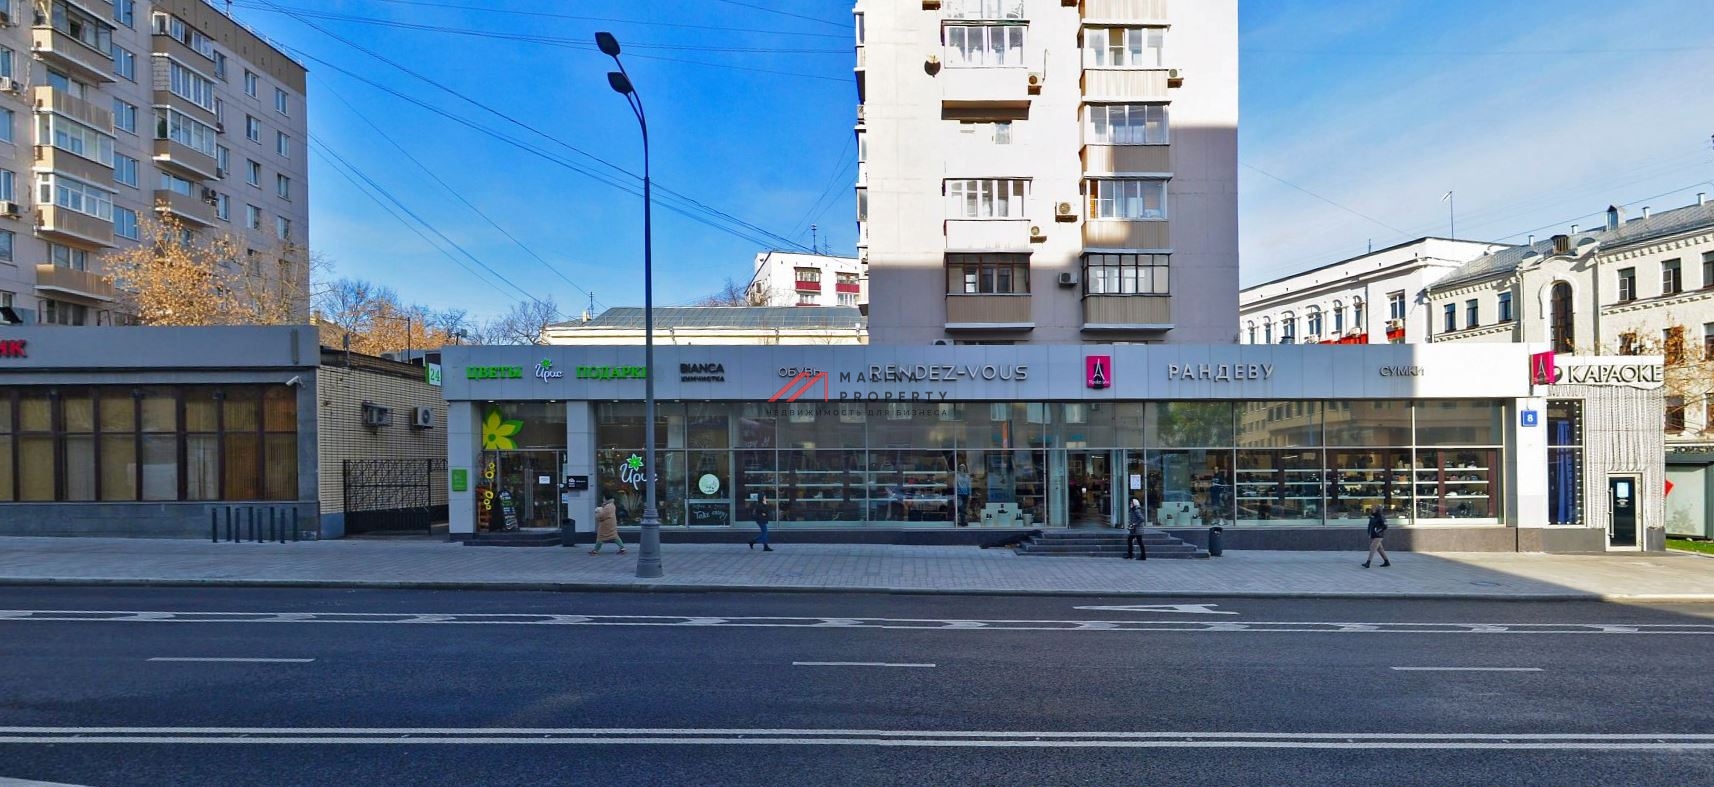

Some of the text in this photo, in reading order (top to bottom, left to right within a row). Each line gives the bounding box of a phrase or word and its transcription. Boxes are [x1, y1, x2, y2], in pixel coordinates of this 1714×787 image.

[430, 368, 440, 381] 24
[466, 366, 522, 379] ЦВЕТЫ
[535, 363, 563, 382] Ирис
[680, 362, 724, 374] BIANCA
[778, 366, 822, 377] ОБУВЬ
[869, 364, 1029, 382] RENDEZ-VOUS
[1168, 363, 1274, 382] РАНДЕВУ
[1379, 365, 1425, 377] СУМКИ
[1568, 364, 1663, 383] КАРАОКЕ
[1527, 413, 1534, 422] 8
